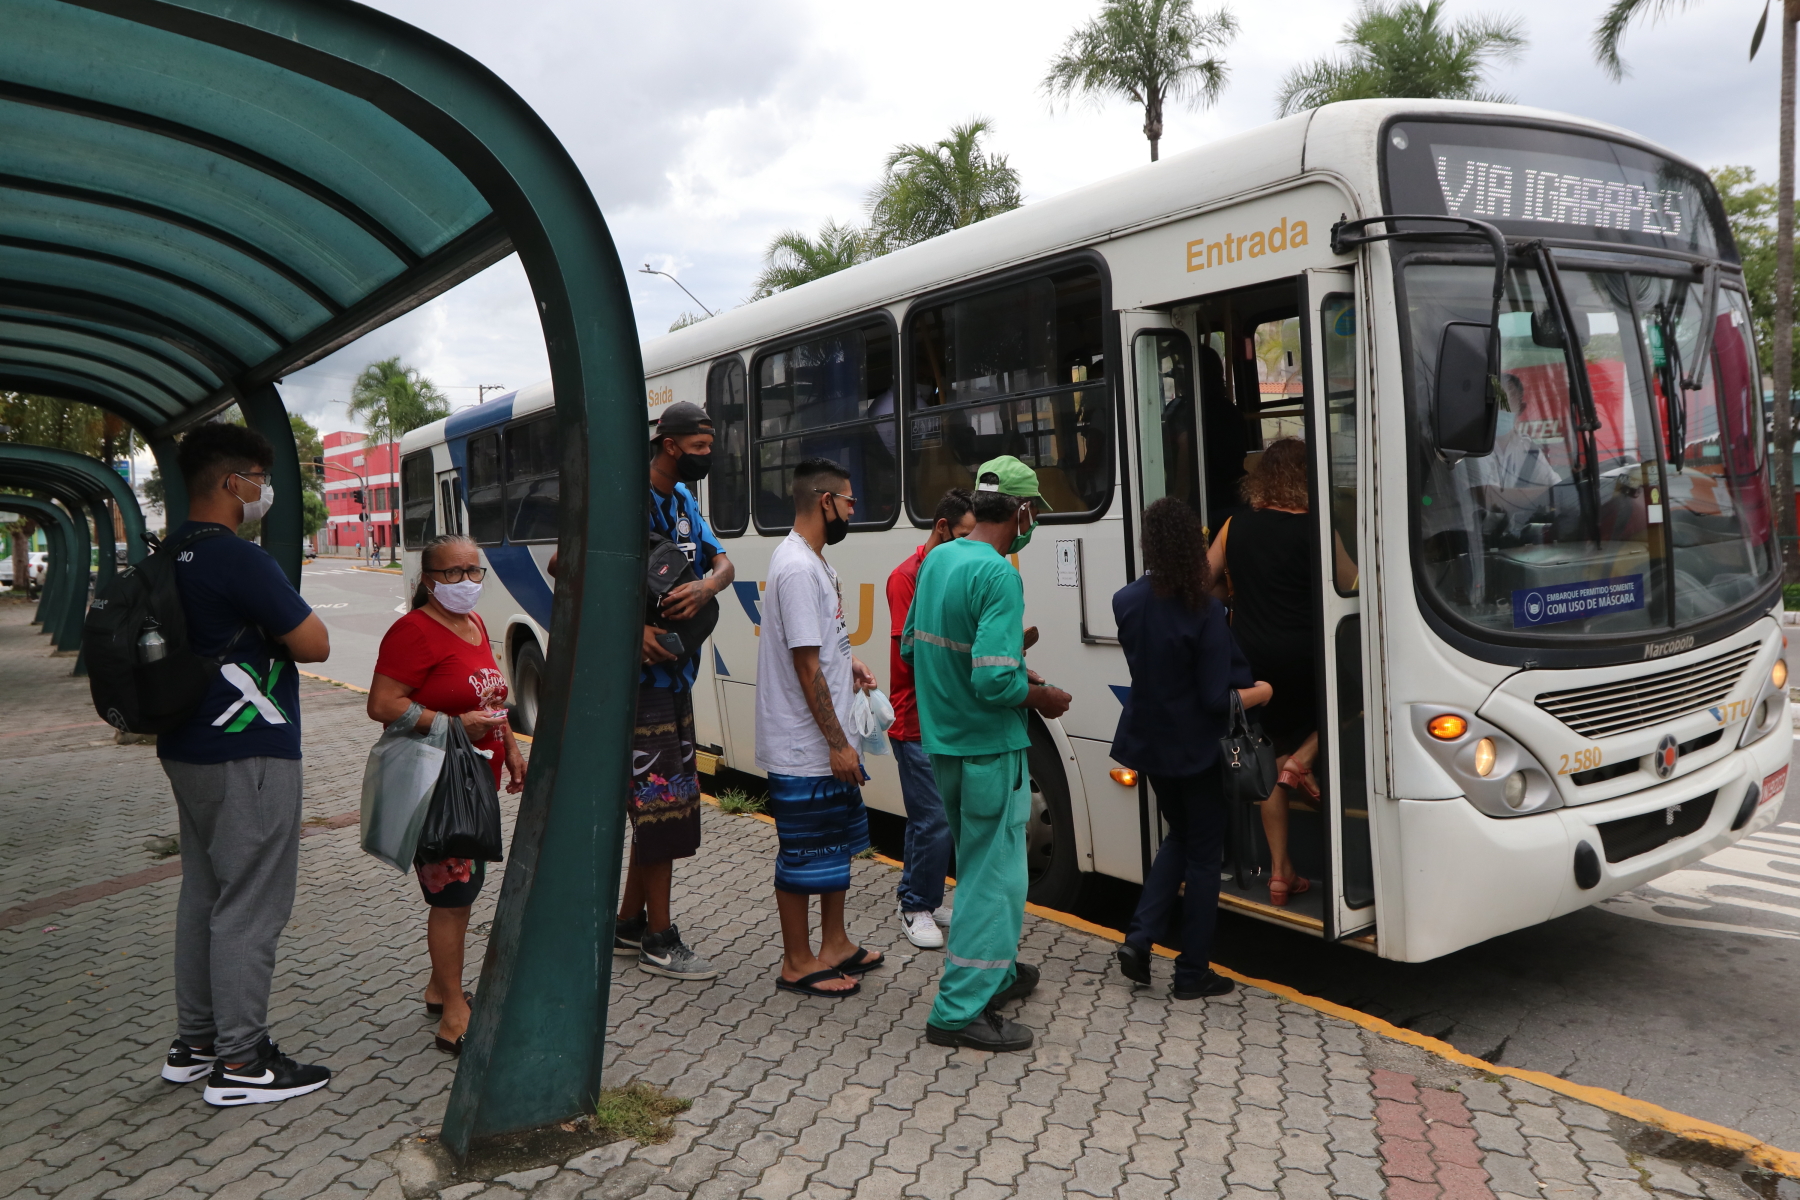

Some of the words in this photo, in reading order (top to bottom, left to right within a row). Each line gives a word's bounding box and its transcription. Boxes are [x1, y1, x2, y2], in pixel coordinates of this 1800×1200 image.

[1437, 156, 1513, 217] VIA
[1522, 169, 1684, 236] IGARAPES
[1187, 216, 1308, 273] Entrada
[648, 385, 673, 407] Saída
[1546, 590, 1579, 602] EMBARQUE
[1580, 585, 1609, 597] PERMITIDO
[1609, 582, 1635, 592] SOMENTE
[1547, 603, 1567, 615] COM
[1569, 601, 1585, 612] USO
[1587, 598, 1597, 609] DE
[1599, 593, 1635, 607] MÁSCARA
[1644, 635, 1694, 659] Marcopolo
[1717, 697, 1753, 726] JTU
[1557, 746, 1602, 775] 2.580
